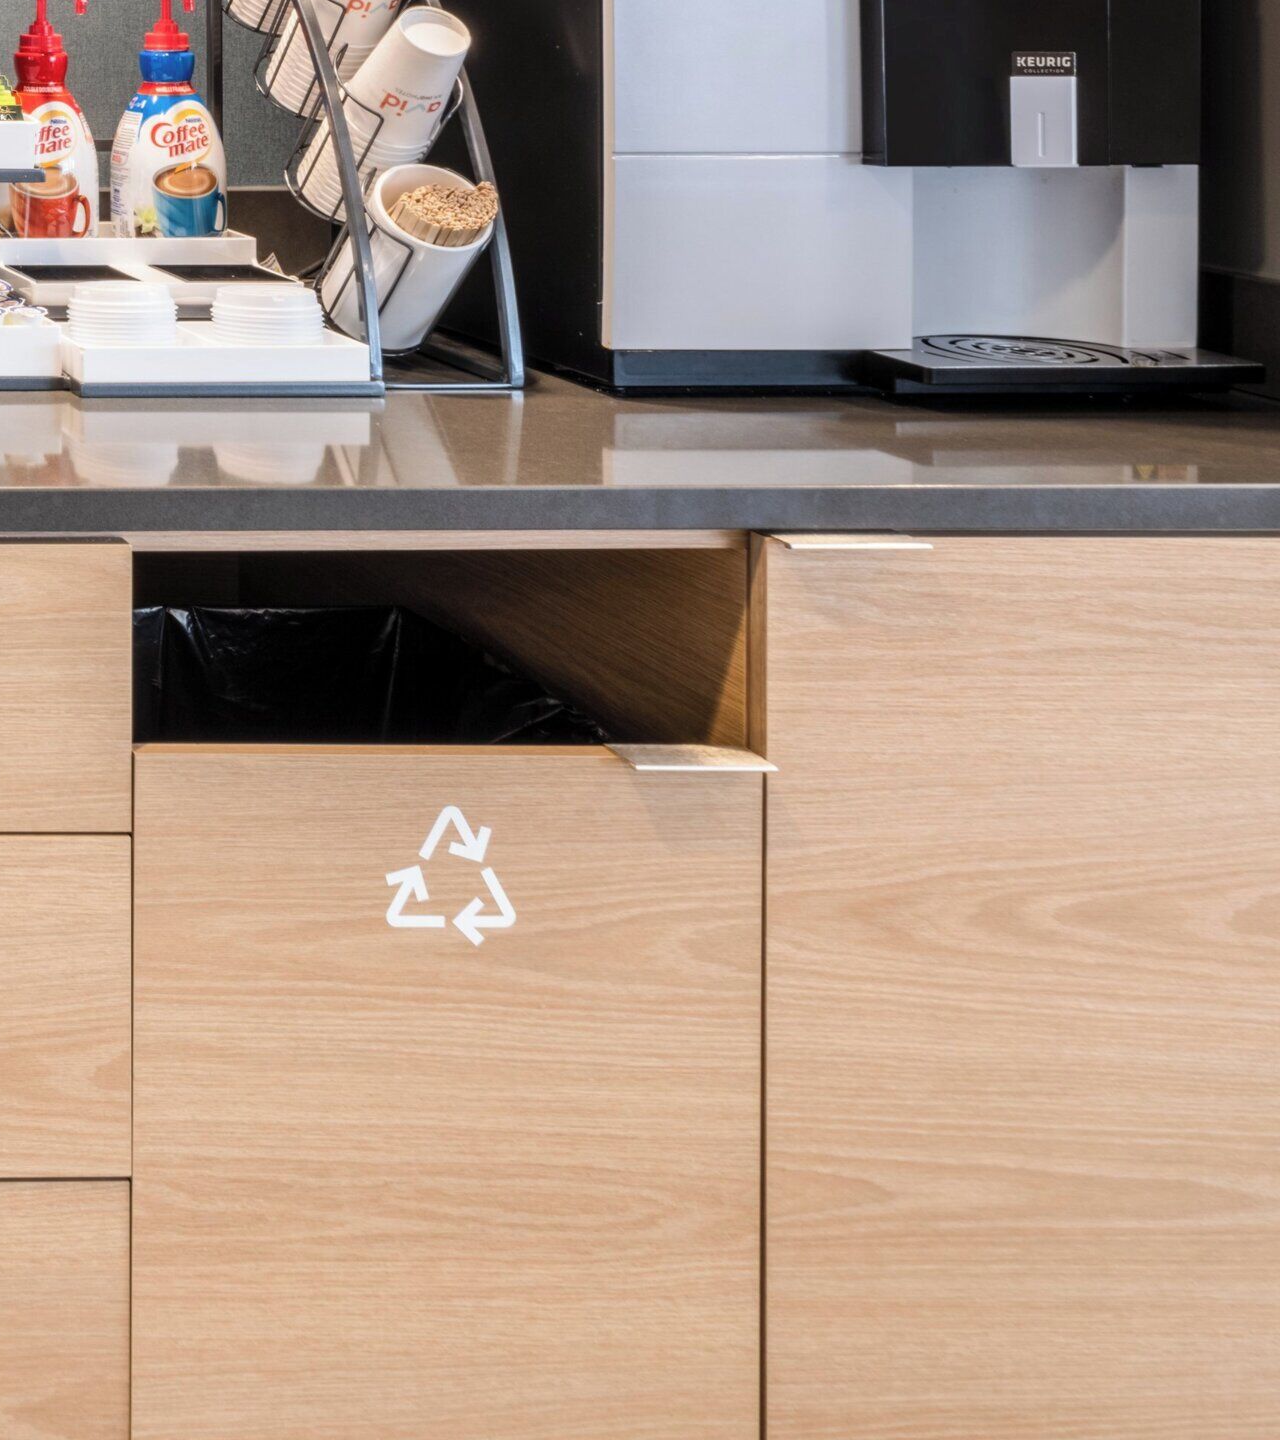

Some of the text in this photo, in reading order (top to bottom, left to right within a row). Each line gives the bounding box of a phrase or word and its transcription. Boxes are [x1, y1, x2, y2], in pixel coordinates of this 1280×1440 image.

[1016, 56, 1071, 67] KEURIG
[380, 93, 441, 116] avid
[38, 125, 70, 143] ffee
[151, 122, 205, 148] Coffee
[169, 135, 209, 158] mate
